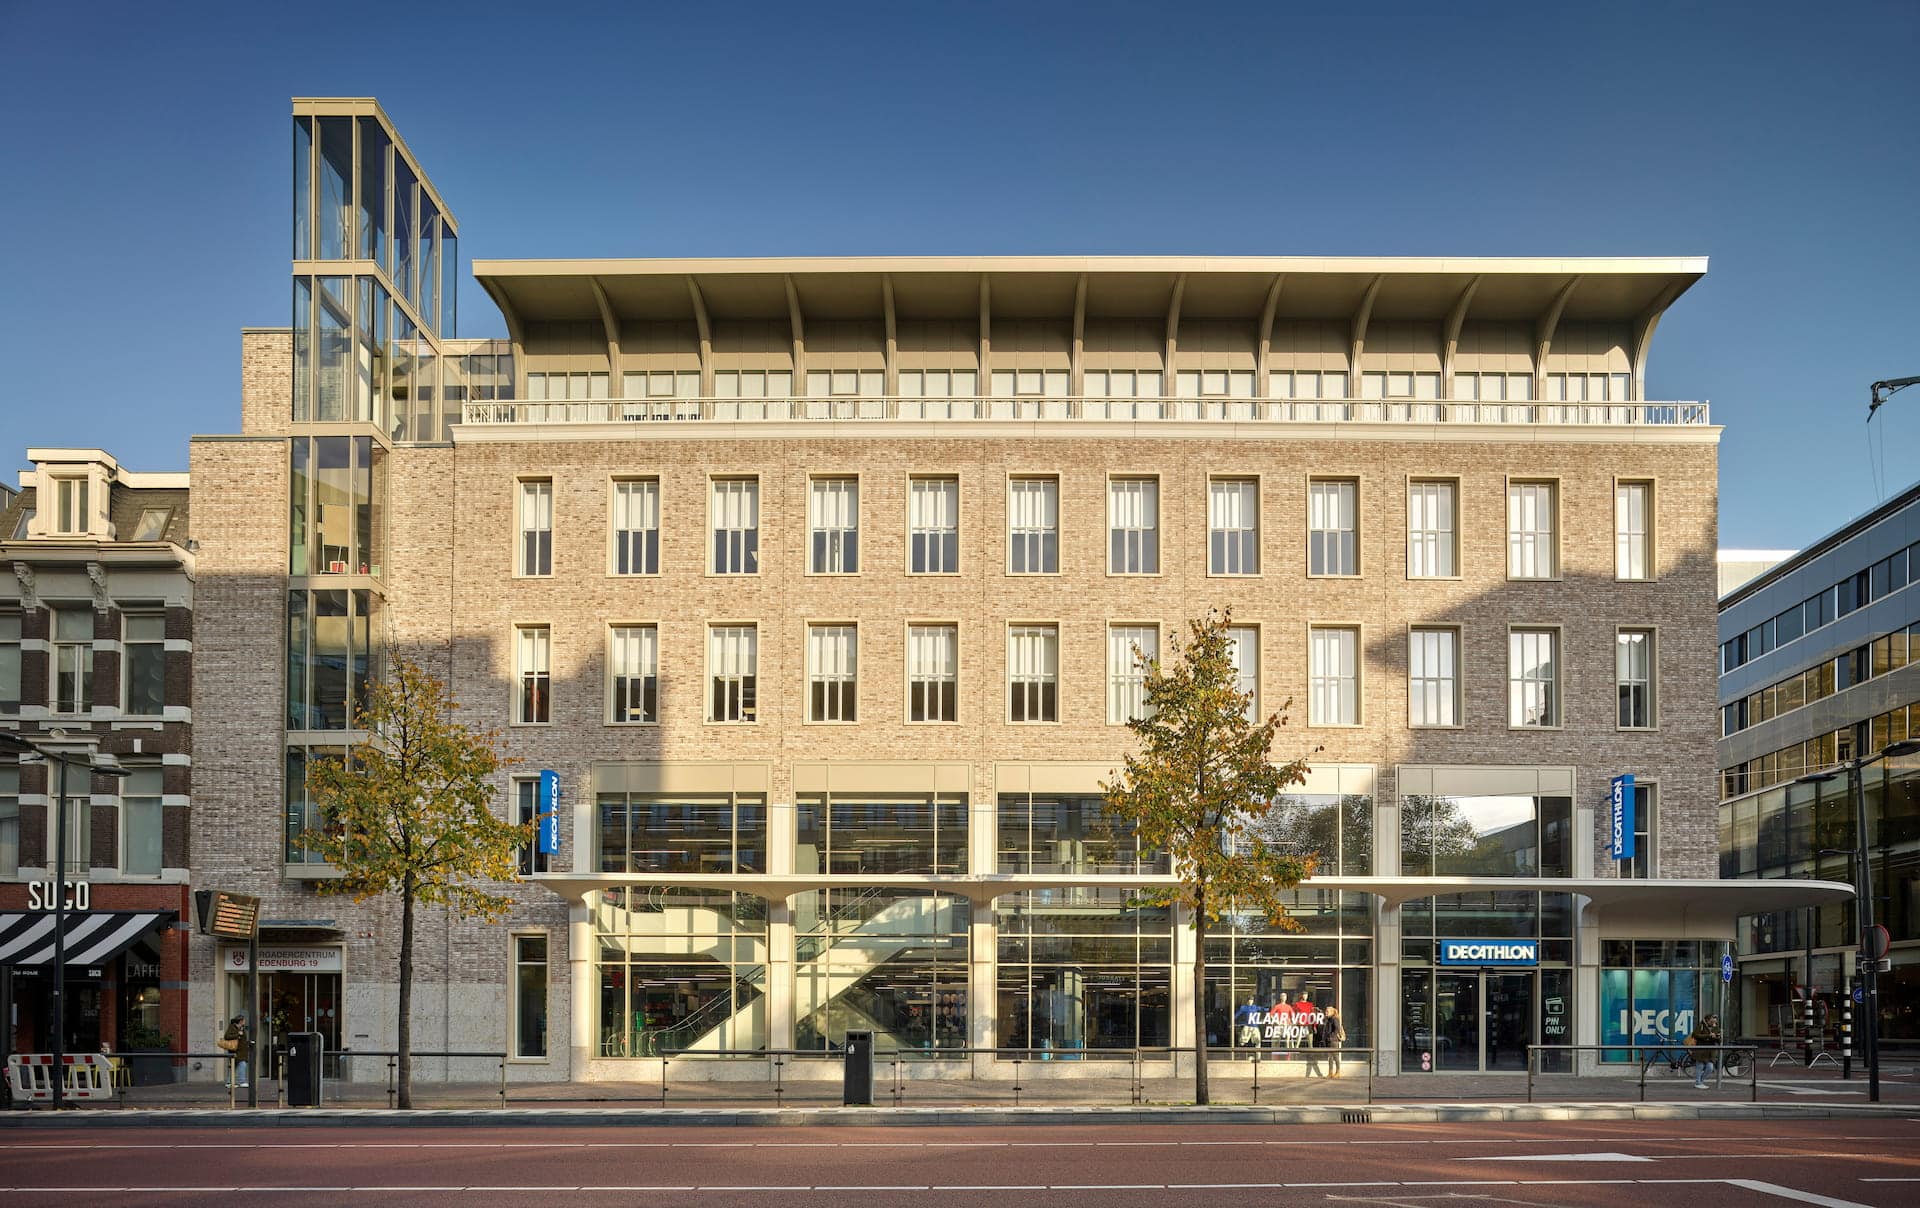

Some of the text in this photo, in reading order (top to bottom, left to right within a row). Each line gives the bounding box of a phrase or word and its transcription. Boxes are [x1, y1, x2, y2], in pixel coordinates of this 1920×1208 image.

[1615, 780, 1623, 854] DECATHLON
[28, 881, 89, 910] SUGO
[258, 951, 336, 959] RGADERCENTRUM
[1449, 945, 1534, 960] DECATHLON
[259, 959, 319, 967] EDENBURG 19
[1248, 1012, 1325, 1025] KLAAR VOOR
[1544, 1017, 1559, 1026] PIN
[1264, 1025, 1282, 1038] DE
[1545, 1025, 1567, 1035] ONLY
